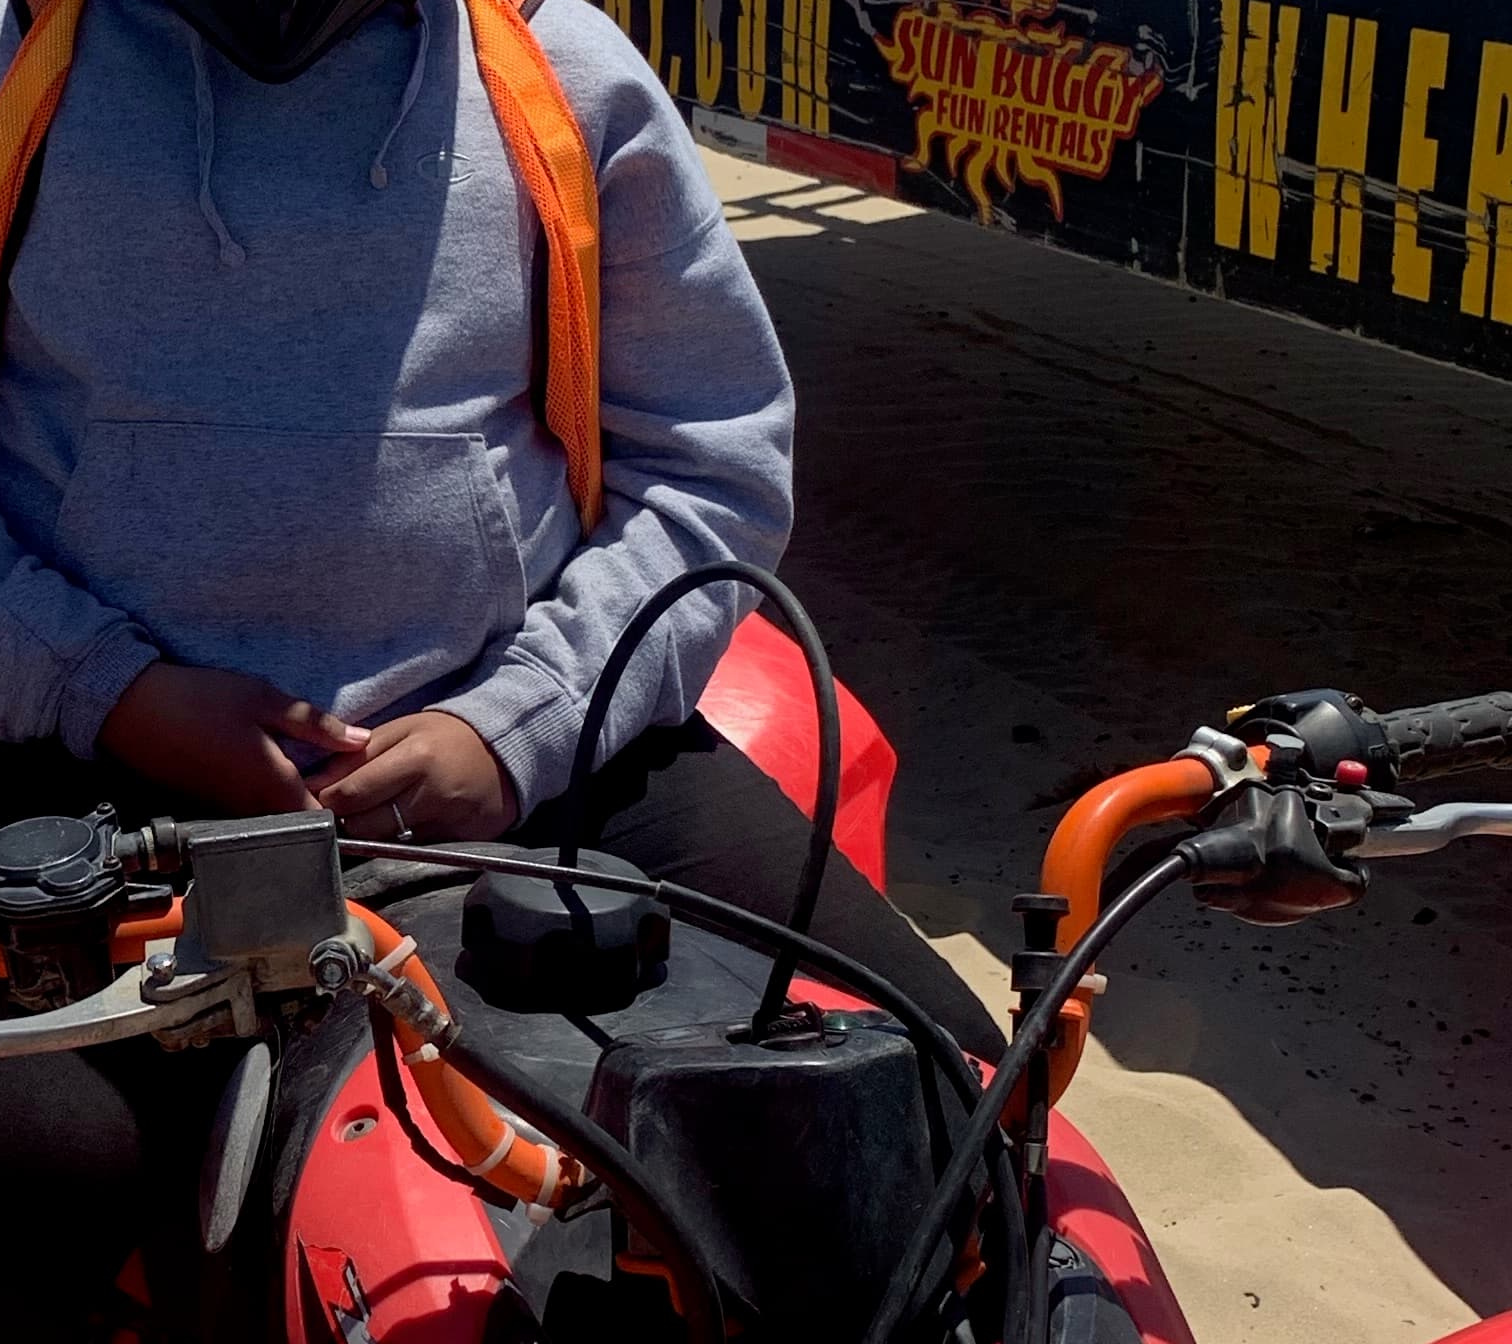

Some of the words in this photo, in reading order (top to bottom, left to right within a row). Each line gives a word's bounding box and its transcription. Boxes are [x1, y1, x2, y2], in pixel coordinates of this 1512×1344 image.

[897, 17, 980, 90] SUN
[991, 41, 1160, 126] BUGGY
[936, 90, 987, 135] FUN
[993, 104, 1107, 166] RENTALS
